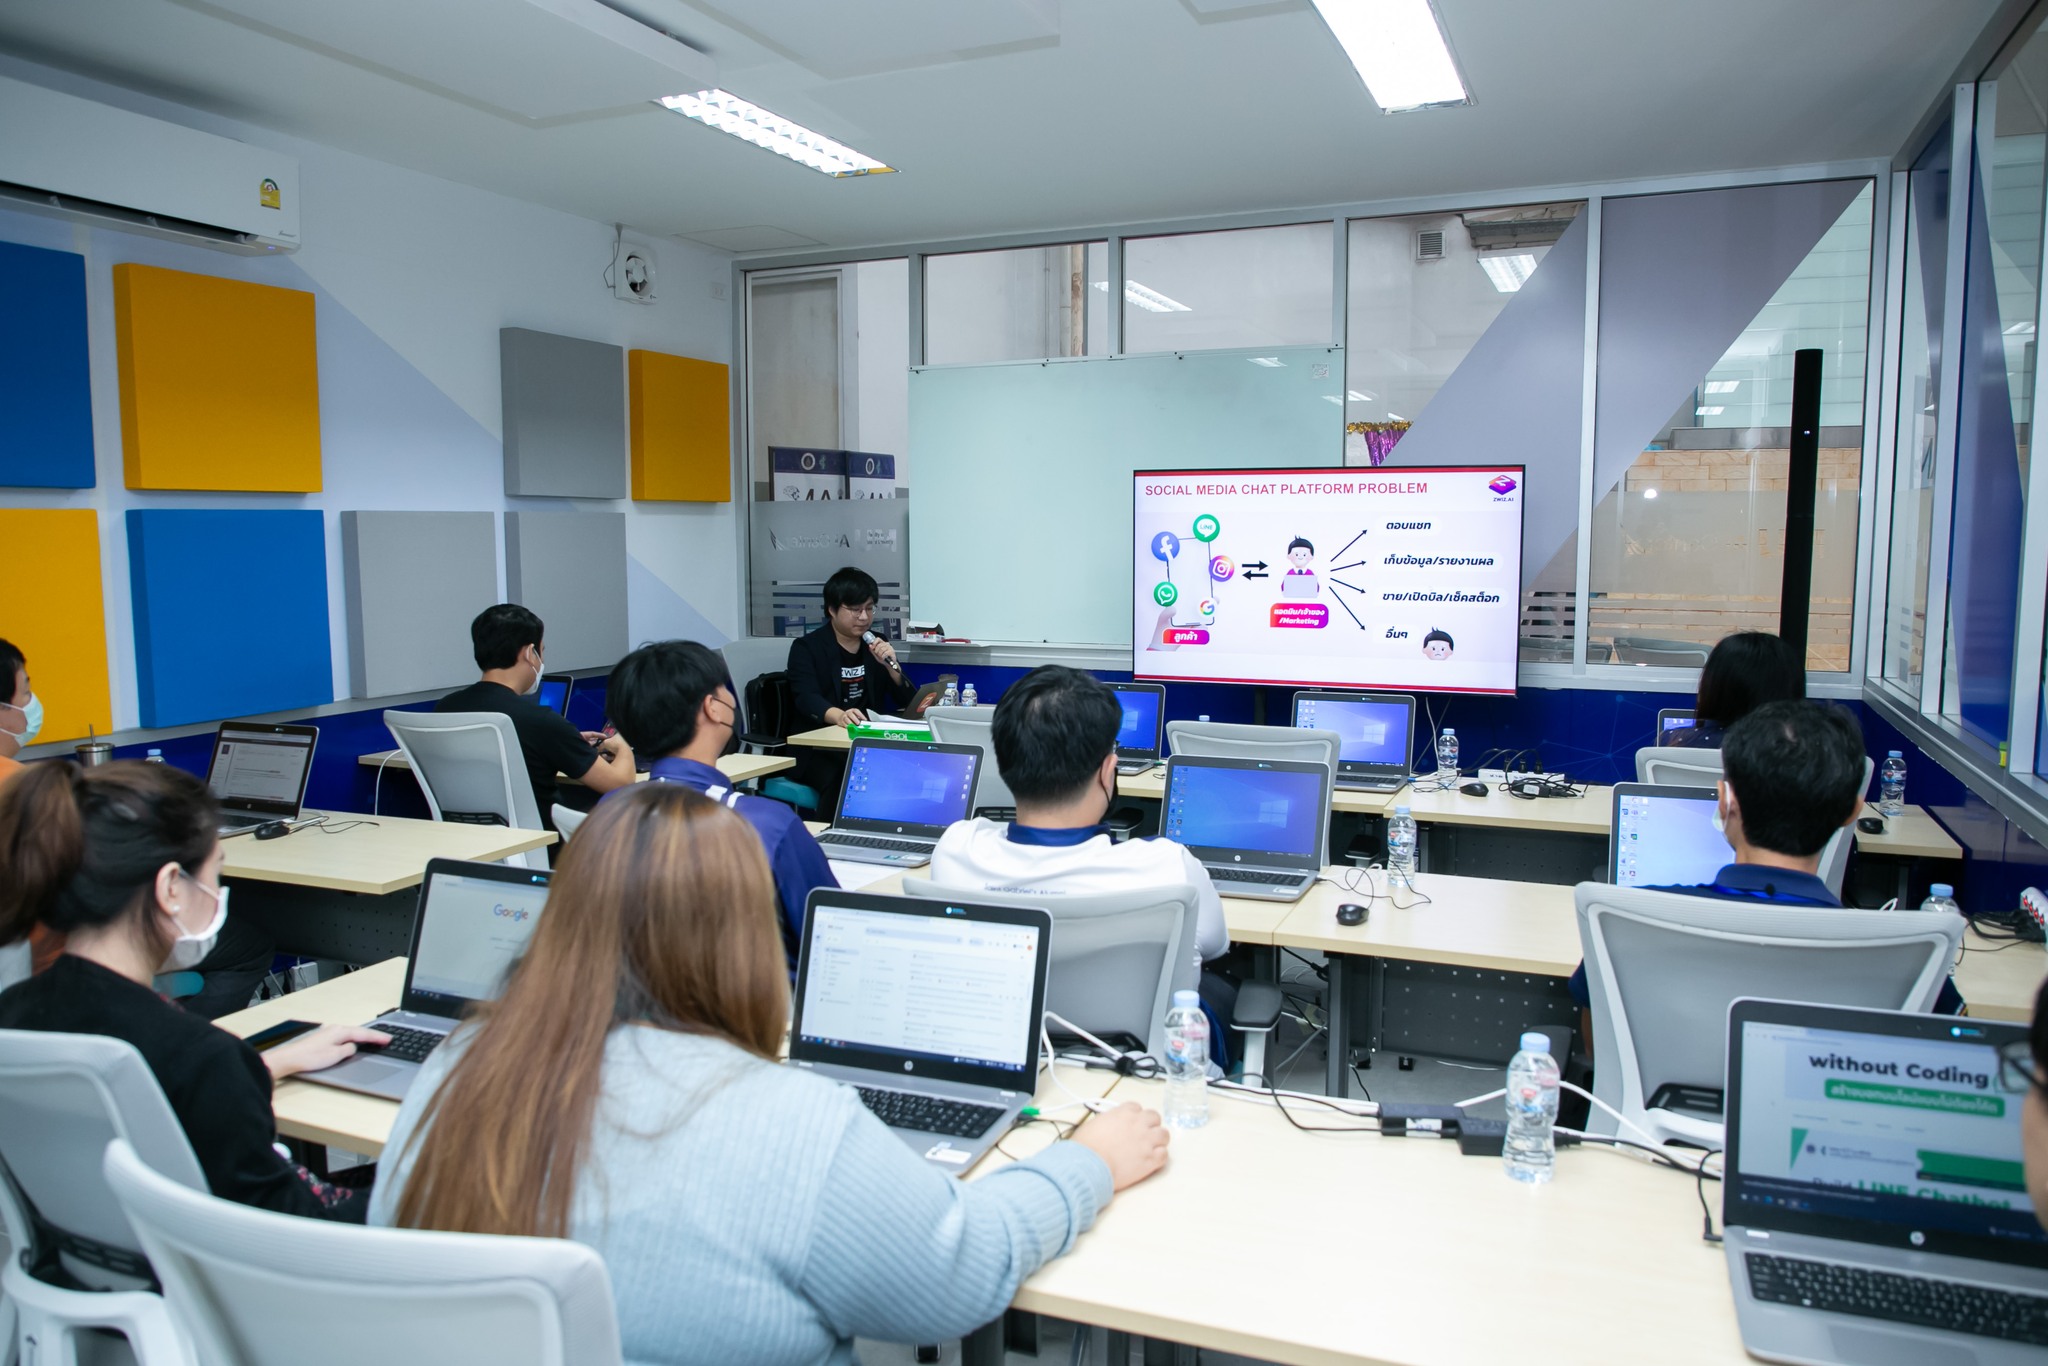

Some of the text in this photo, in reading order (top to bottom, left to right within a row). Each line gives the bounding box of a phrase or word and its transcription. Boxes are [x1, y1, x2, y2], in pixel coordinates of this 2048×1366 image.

[1145, 482, 1428, 496] SOCIAL MEDIA CHAT PLATFORM PROBLEM
[1386, 522, 1432, 530] ตอบแชท
[1383, 553, 1495, 568] เก็บข้อมูล/รายงานผล
[1382, 590, 1500, 603] ขาย/เปิดบิล/เช็คสต็อก
[1174, 630, 1198, 643] ลูกค้า
[1385, 626, 1409, 639] อื่นๆ
[493, 903, 529, 922] Google
[1809, 1053, 1989, 1089] without Coding
